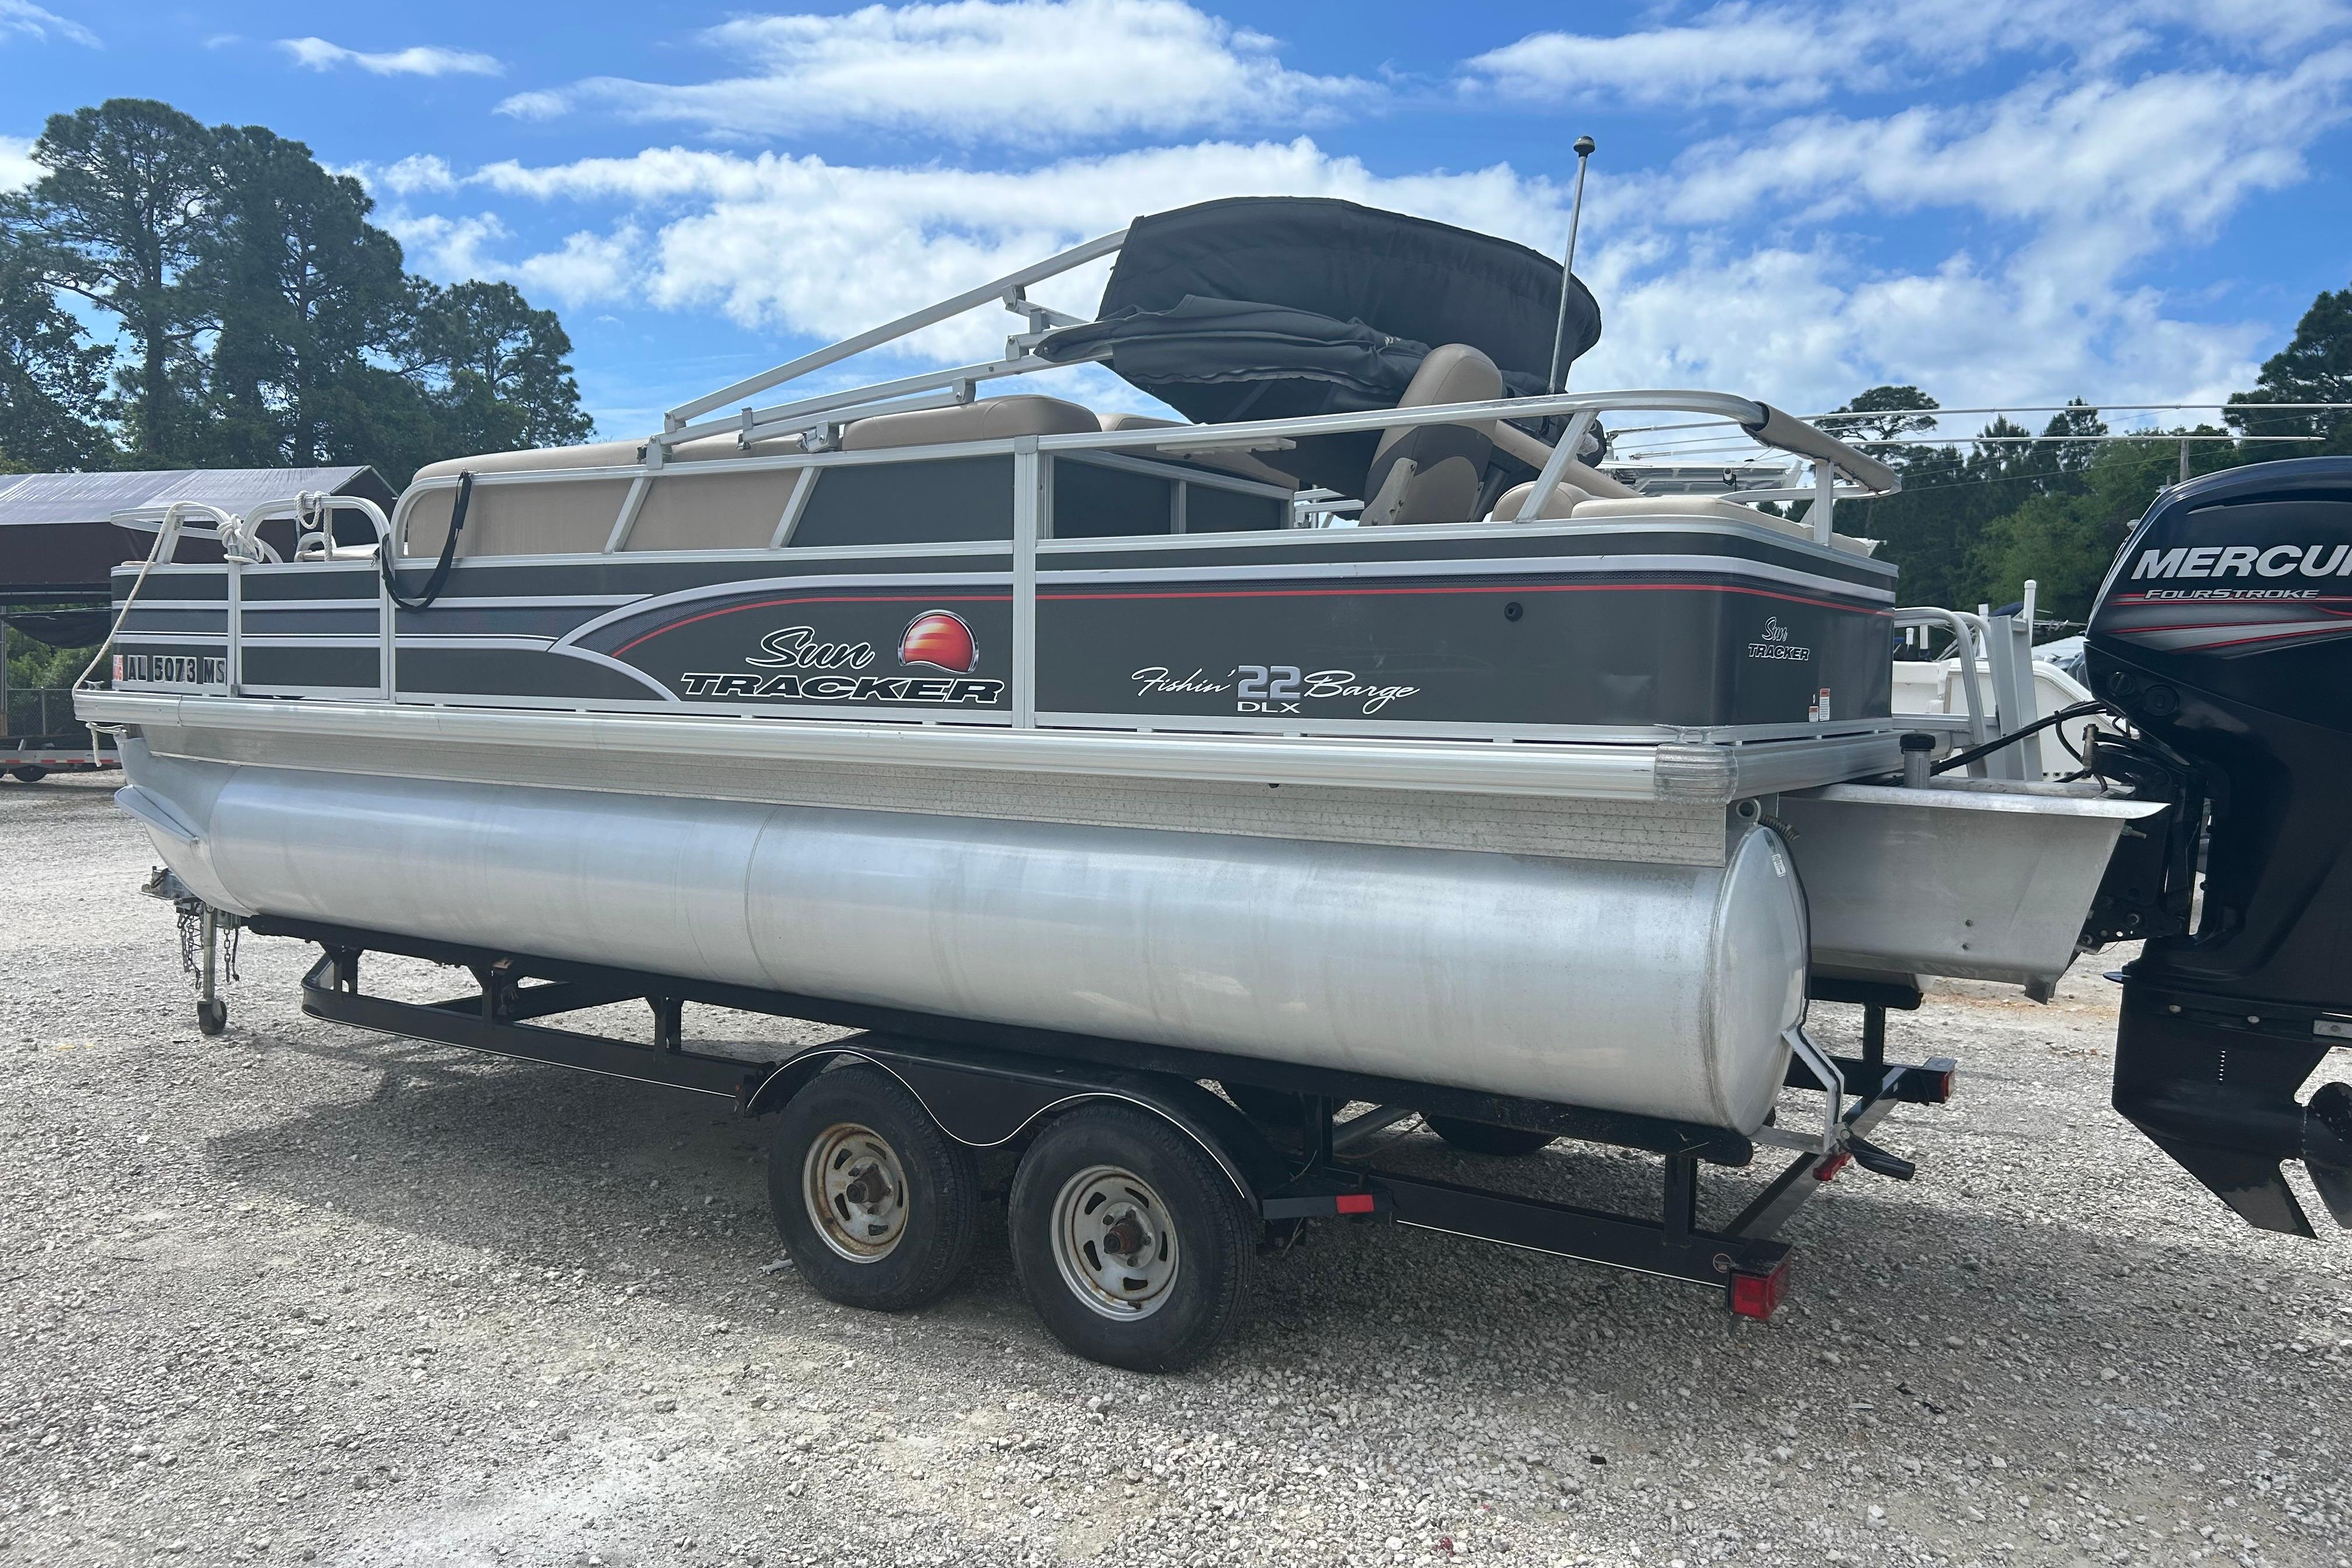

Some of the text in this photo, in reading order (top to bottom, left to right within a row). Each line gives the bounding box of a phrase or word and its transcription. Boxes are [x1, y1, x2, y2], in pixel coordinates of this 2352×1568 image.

[1762, 616, 1788, 642] Sun
[746, 626, 876, 669] Sun
[1748, 643, 1810, 660] TRACKER
[129, 657, 225, 684] AL 5073 MS
[680, 673, 1005, 704] TRACKER
[1132, 666, 1420, 714] Fishin' 22 Barge
[1237, 701, 1300, 713] DLX
